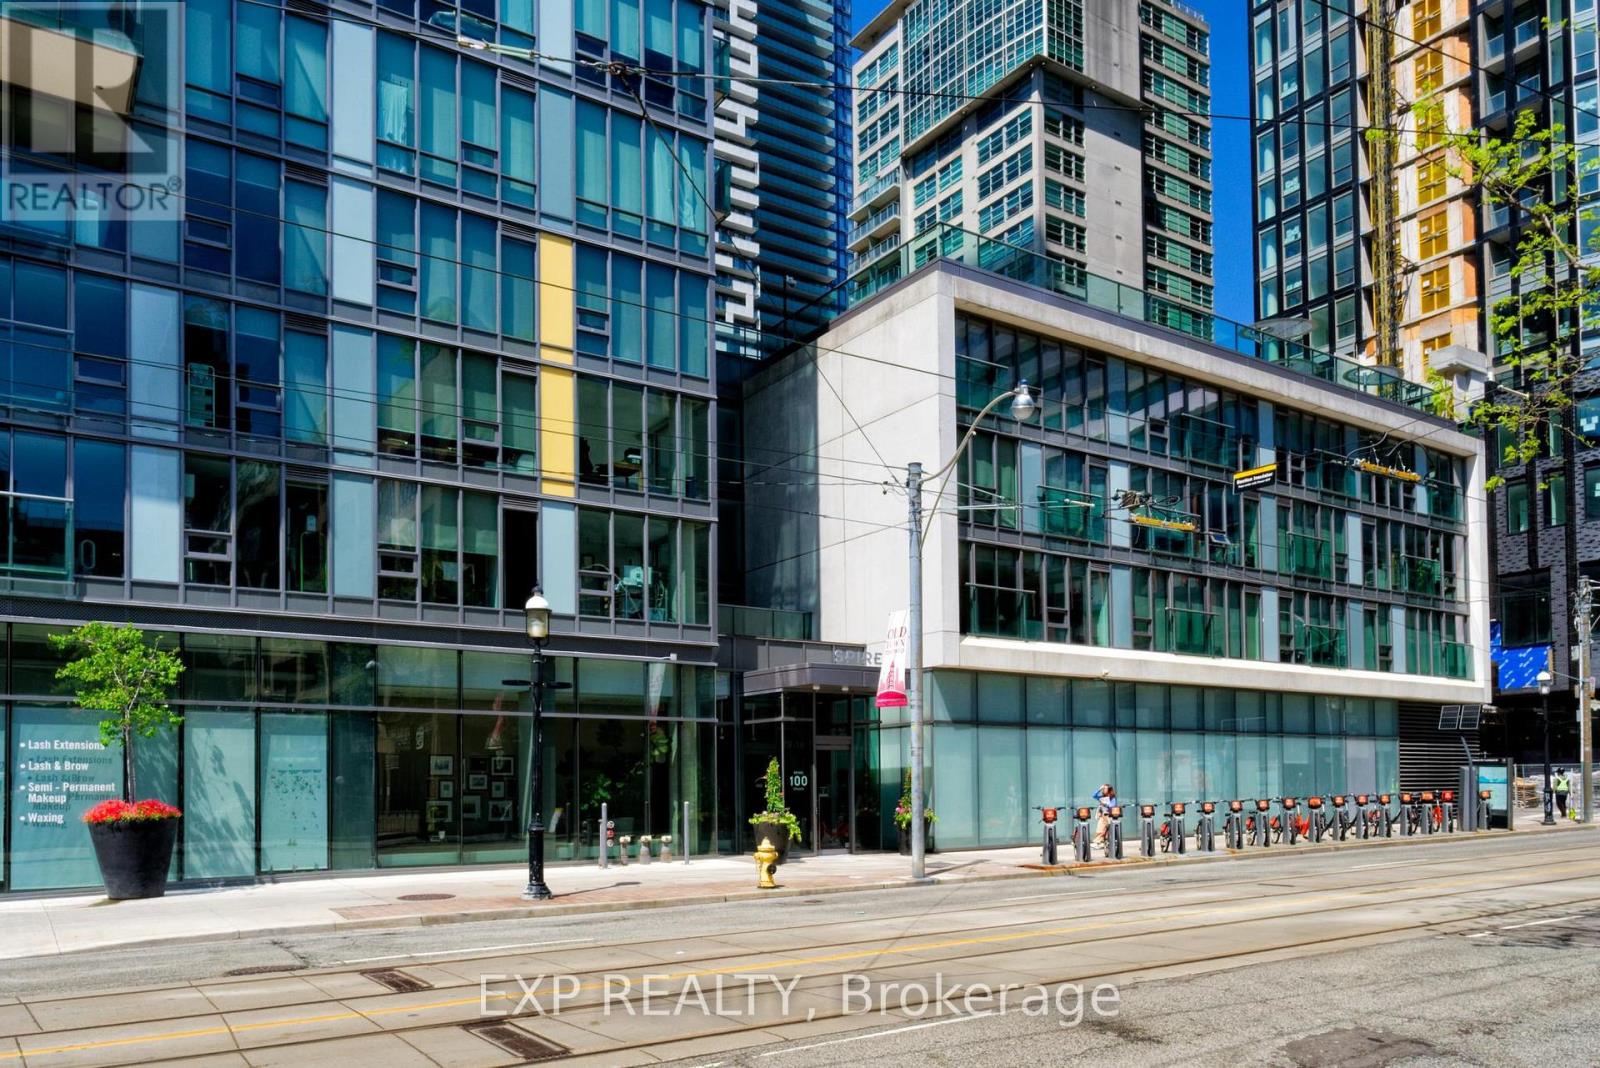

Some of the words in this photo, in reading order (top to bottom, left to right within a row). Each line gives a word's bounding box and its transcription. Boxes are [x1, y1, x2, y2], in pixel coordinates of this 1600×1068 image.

[834, 649, 883, 666] SPIRE
[28, 740, 51, 750] Lash
[54, 740, 105, 750] Extensions
[28, 761, 51, 771] Lash
[54, 761, 61, 771] &
[64, 761, 89, 771] Brow
[790, 775, 808, 787] 100
[28, 782, 53, 792] Semi
[63, 782, 115, 792] Permanent
[28, 793, 67, 804] Makeup
[28, 813, 64, 824] Waxing
